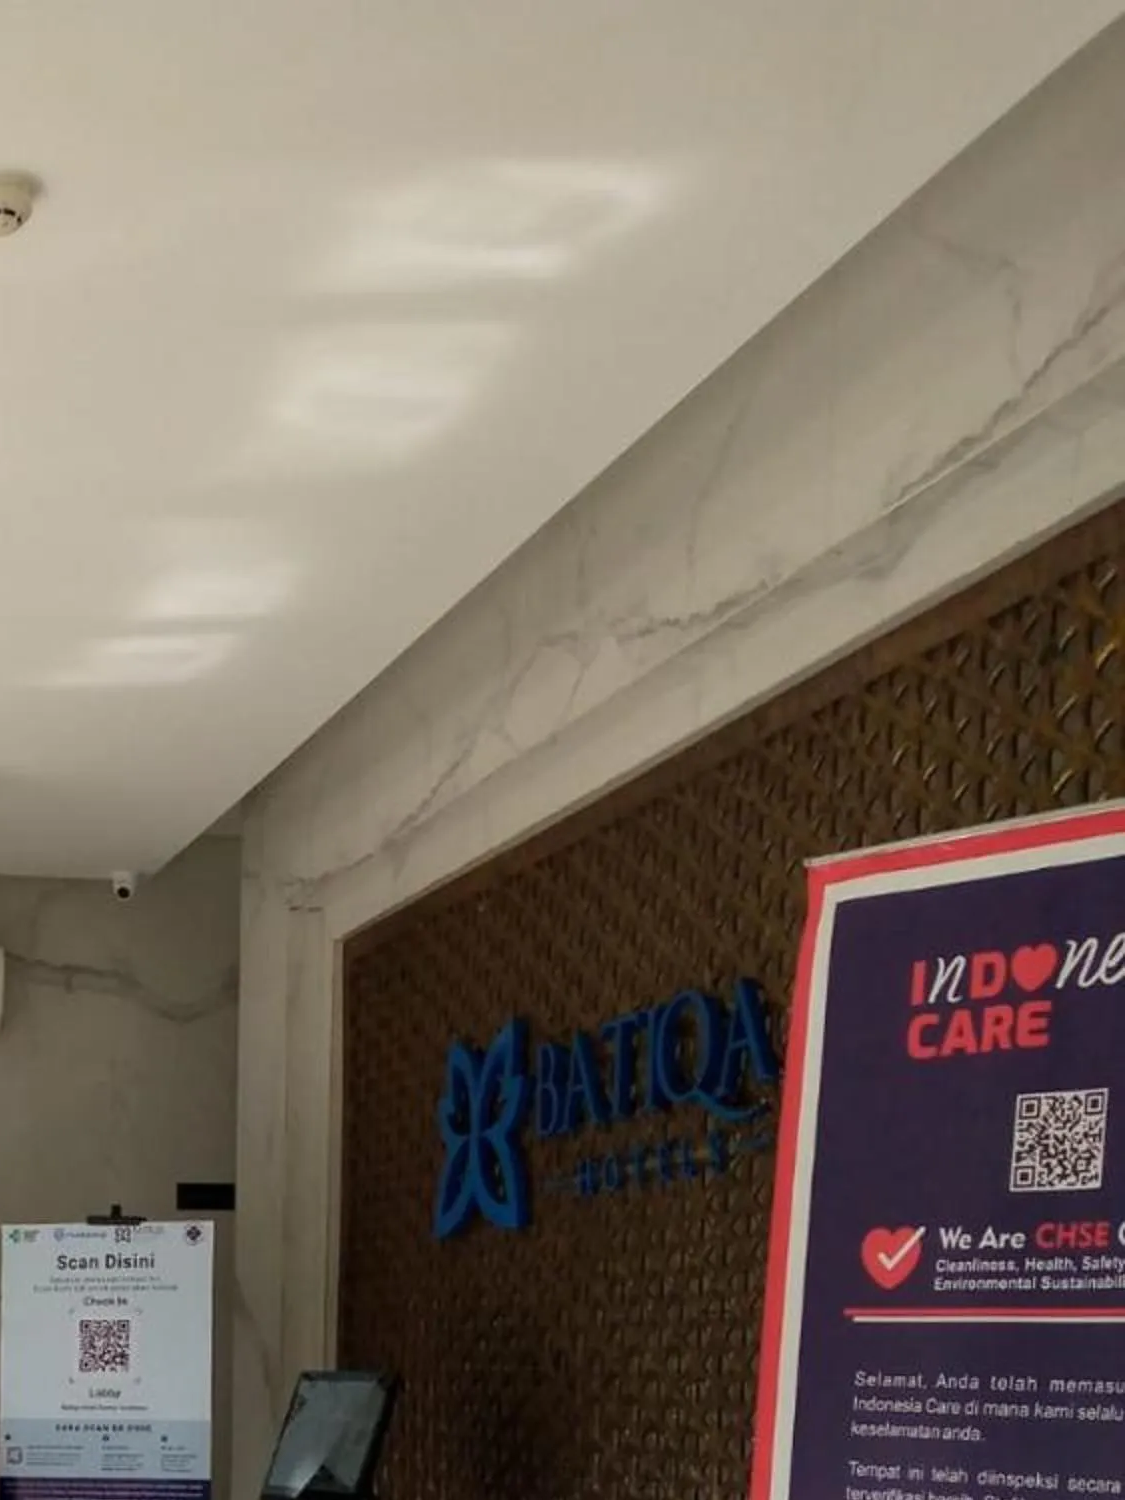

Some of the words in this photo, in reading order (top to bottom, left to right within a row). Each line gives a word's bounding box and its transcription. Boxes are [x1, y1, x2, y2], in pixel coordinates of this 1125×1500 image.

[907, 1000, 1052, 1060] CARE
[533, 976, 779, 1137] BATIQA
[575, 1131, 731, 1197] HOTELS
[939, 1226, 972, 1250] We
[979, 1226, 1026, 1249] Are
[1035, 1222, 1110, 1249] CHSE
[56, 1254, 99, 1271] Scan
[105, 1252, 155, 1269] Disini
[936, 1258, 1020, 1272] Cleanliness,
[1025, 1257, 1077, 1272] Health,
[934, 1277, 1036, 1291] Environmental
[936, 1373, 979, 1390] Anda
[990, 1375, 1037, 1392] telah
[853, 1396, 922, 1413] Indonesia
[926, 1398, 961, 1415] Care
[965, 1400, 978, 1416] di
[983, 1402, 1029, 1417] mana
[1034, 1403, 1073, 1419] kami
[1077, 1405, 1124, 1421] selalu
[851, 1421, 940, 1439] keselamatan
[942, 1426, 985, 1441] anda.
[848, 1461, 901, 1482] Tempat
[909, 1466, 923, 1481] ini
[931, 1467, 968, 1483] telah
[977, 1469, 1059, 1490] diinspeksi
[1067, 1476, 1121, 1494] secara
